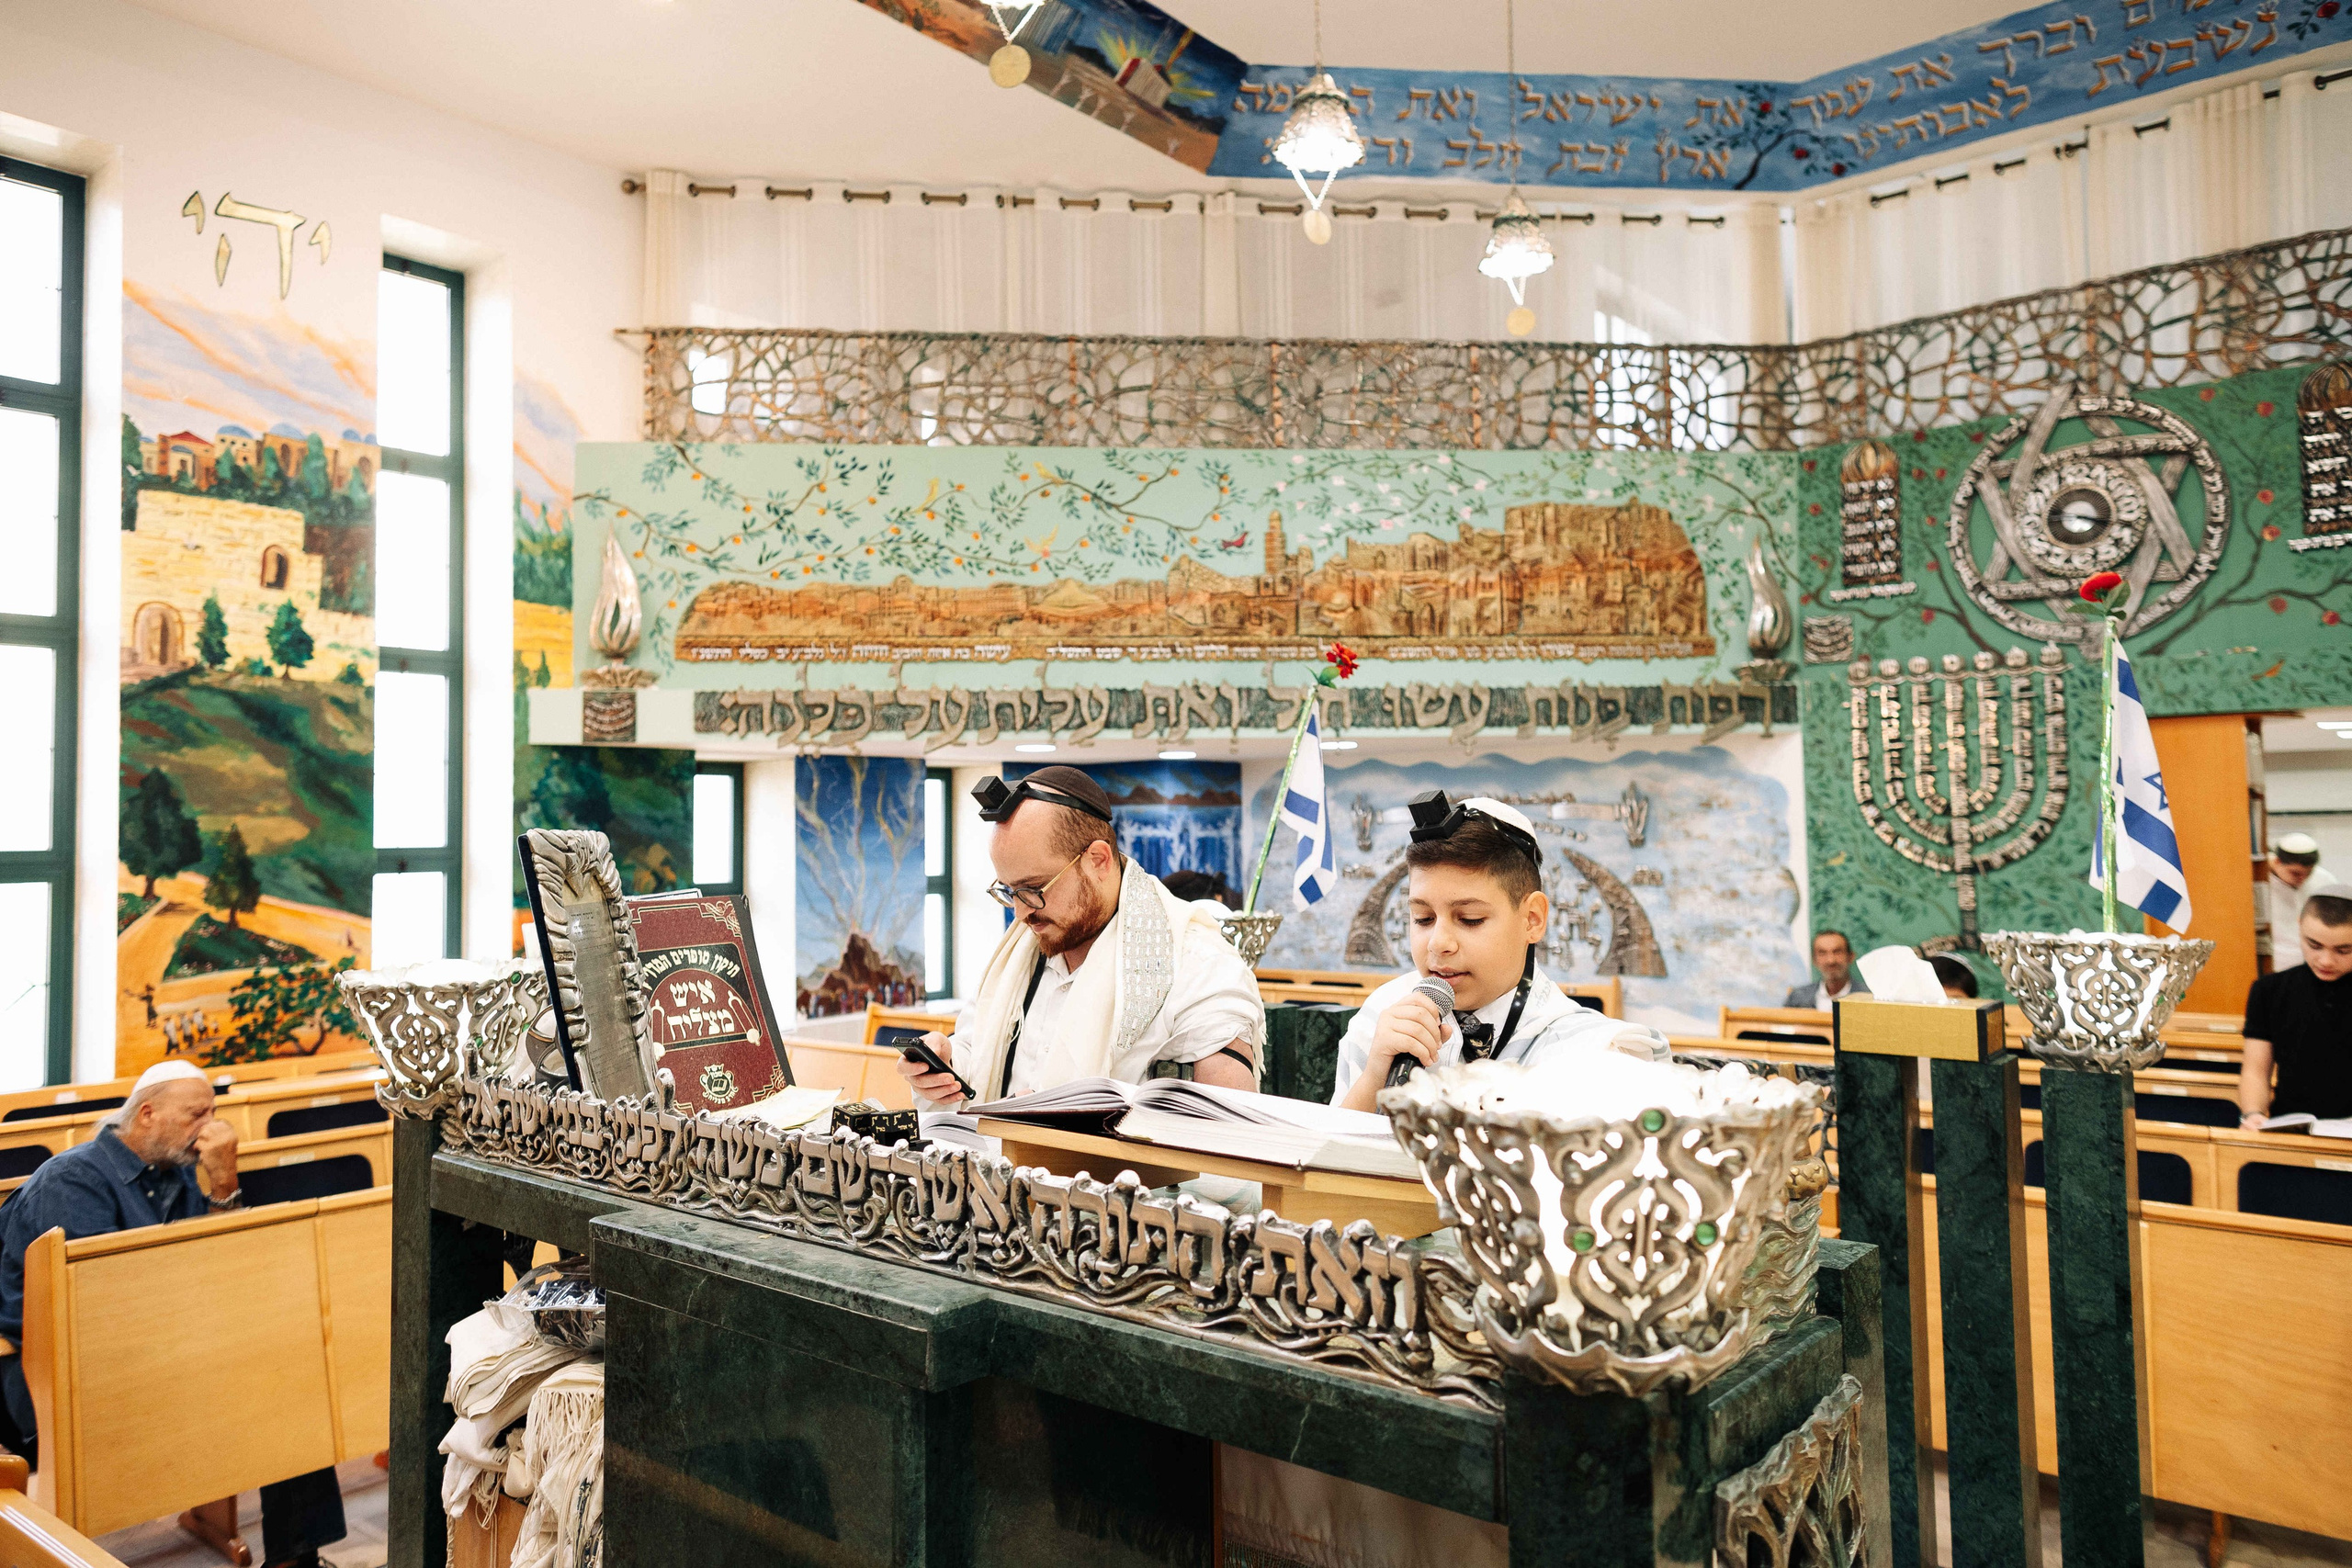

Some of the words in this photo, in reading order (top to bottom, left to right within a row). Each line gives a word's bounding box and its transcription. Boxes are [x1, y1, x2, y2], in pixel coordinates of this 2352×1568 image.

[1888, 52, 1956, 101] את
[1978, 15, 2098, 77] וברך
[1234, 79, 1374, 116] המה
[1397, 85, 1477, 120] ואת
[1519, 78, 1663, 127] ישראל
[1684, 96, 1747, 130] את
[1790, 75, 1874, 130] עמך
[1657, 131, 1732, 183] ארץ
[977, 660, 1110, 745] עלית
[1133, 680, 1239, 743] ואת
[1383, 681, 1490, 742] עשו
[1517, 678, 1632, 744] בנות
[1652, 679, 1773, 744] רבות
[670, 948, 710, 965] סופרים
[710, 953, 741, 978] תיקון
[667, 1006, 735, 1041] מצליח
[669, 978, 717, 1008] איש
[463, 1041, 550, 1136] ישראל
[553, 1085, 604, 1150] בני
[612, 1067, 689, 1165] לפני
[695, 1109, 786, 1188] משה
[799, 1126, 869, 1205] שם
[1031, 1167, 1230, 1289] התורה
[1252, 1210, 1419, 1334] וזאת
